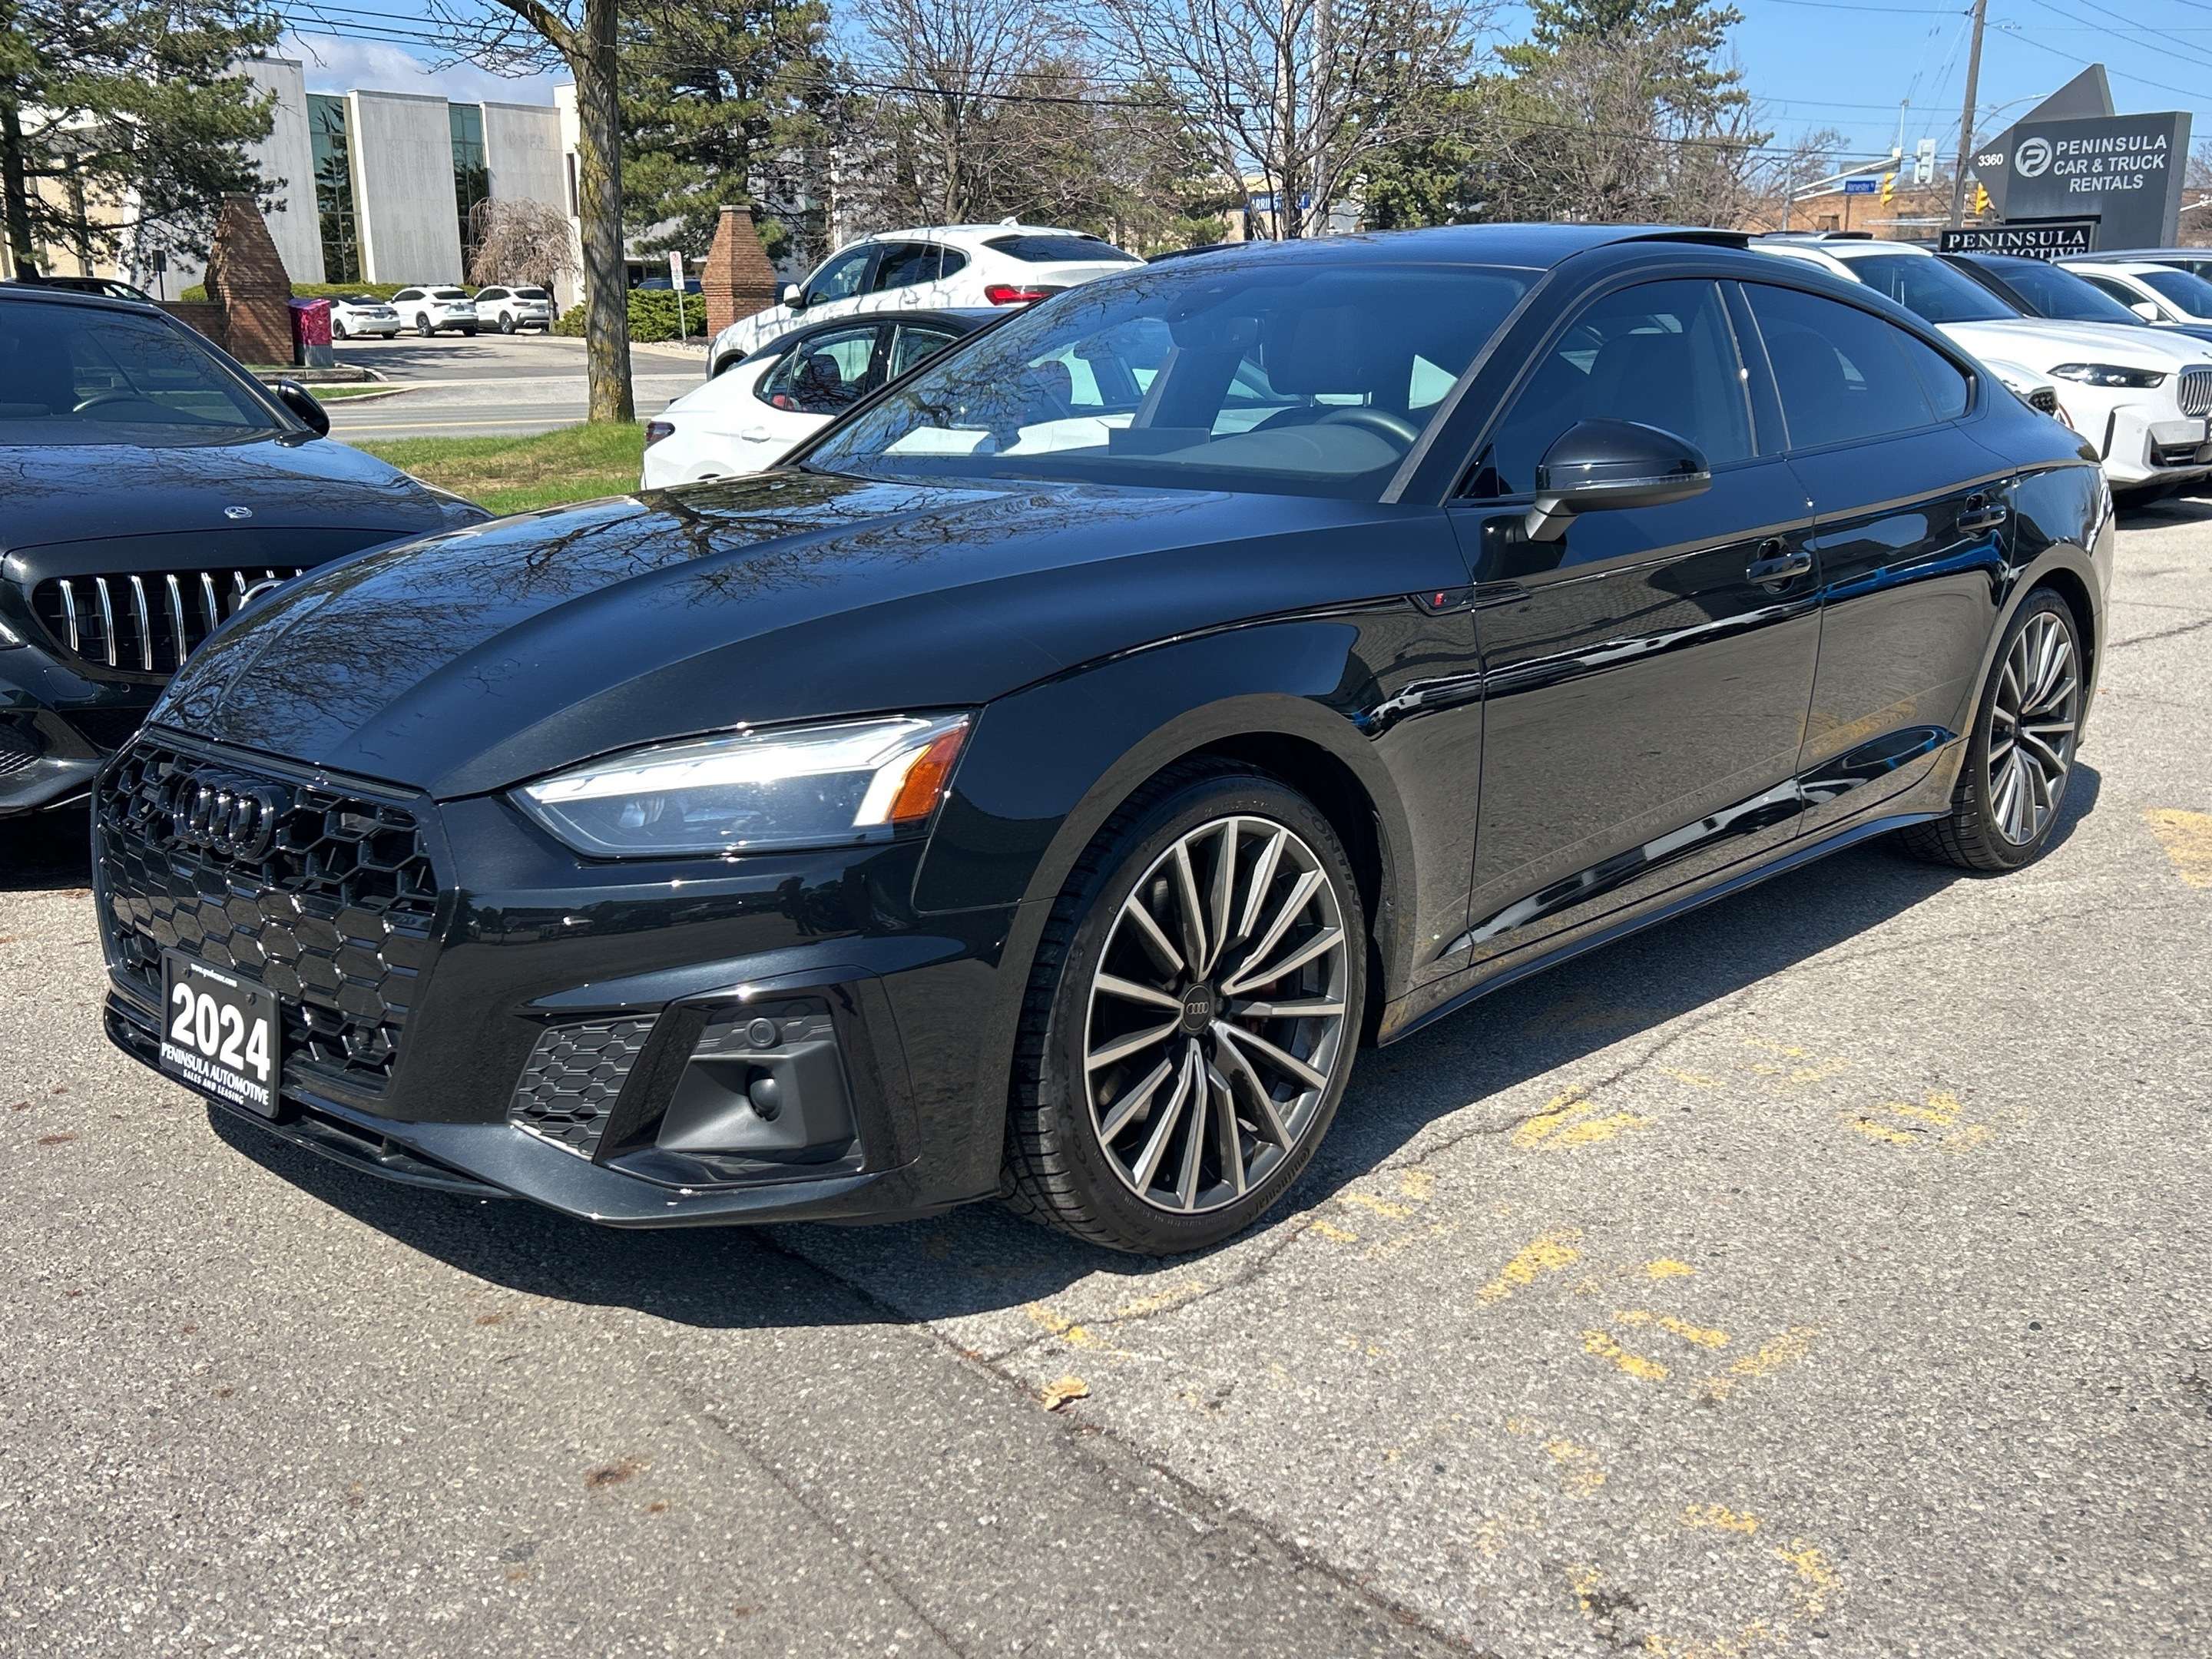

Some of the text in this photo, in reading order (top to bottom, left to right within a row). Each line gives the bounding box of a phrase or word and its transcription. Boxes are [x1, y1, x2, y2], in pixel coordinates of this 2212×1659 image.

[2056, 134, 2168, 155] PENINSULA
[1978, 154, 2004, 167] 3360
[2054, 154, 2166, 176] CAR & TRUCK
[2069, 174, 2144, 193] RENTALS
[1948, 230, 2086, 248] PENINSULA
[171, 982, 271, 1082] 2024
[161, 1041, 270, 1106] PENINSULA AUTOMOTIVE
[183, 1068, 244, 1105] SALES AND LEASING
